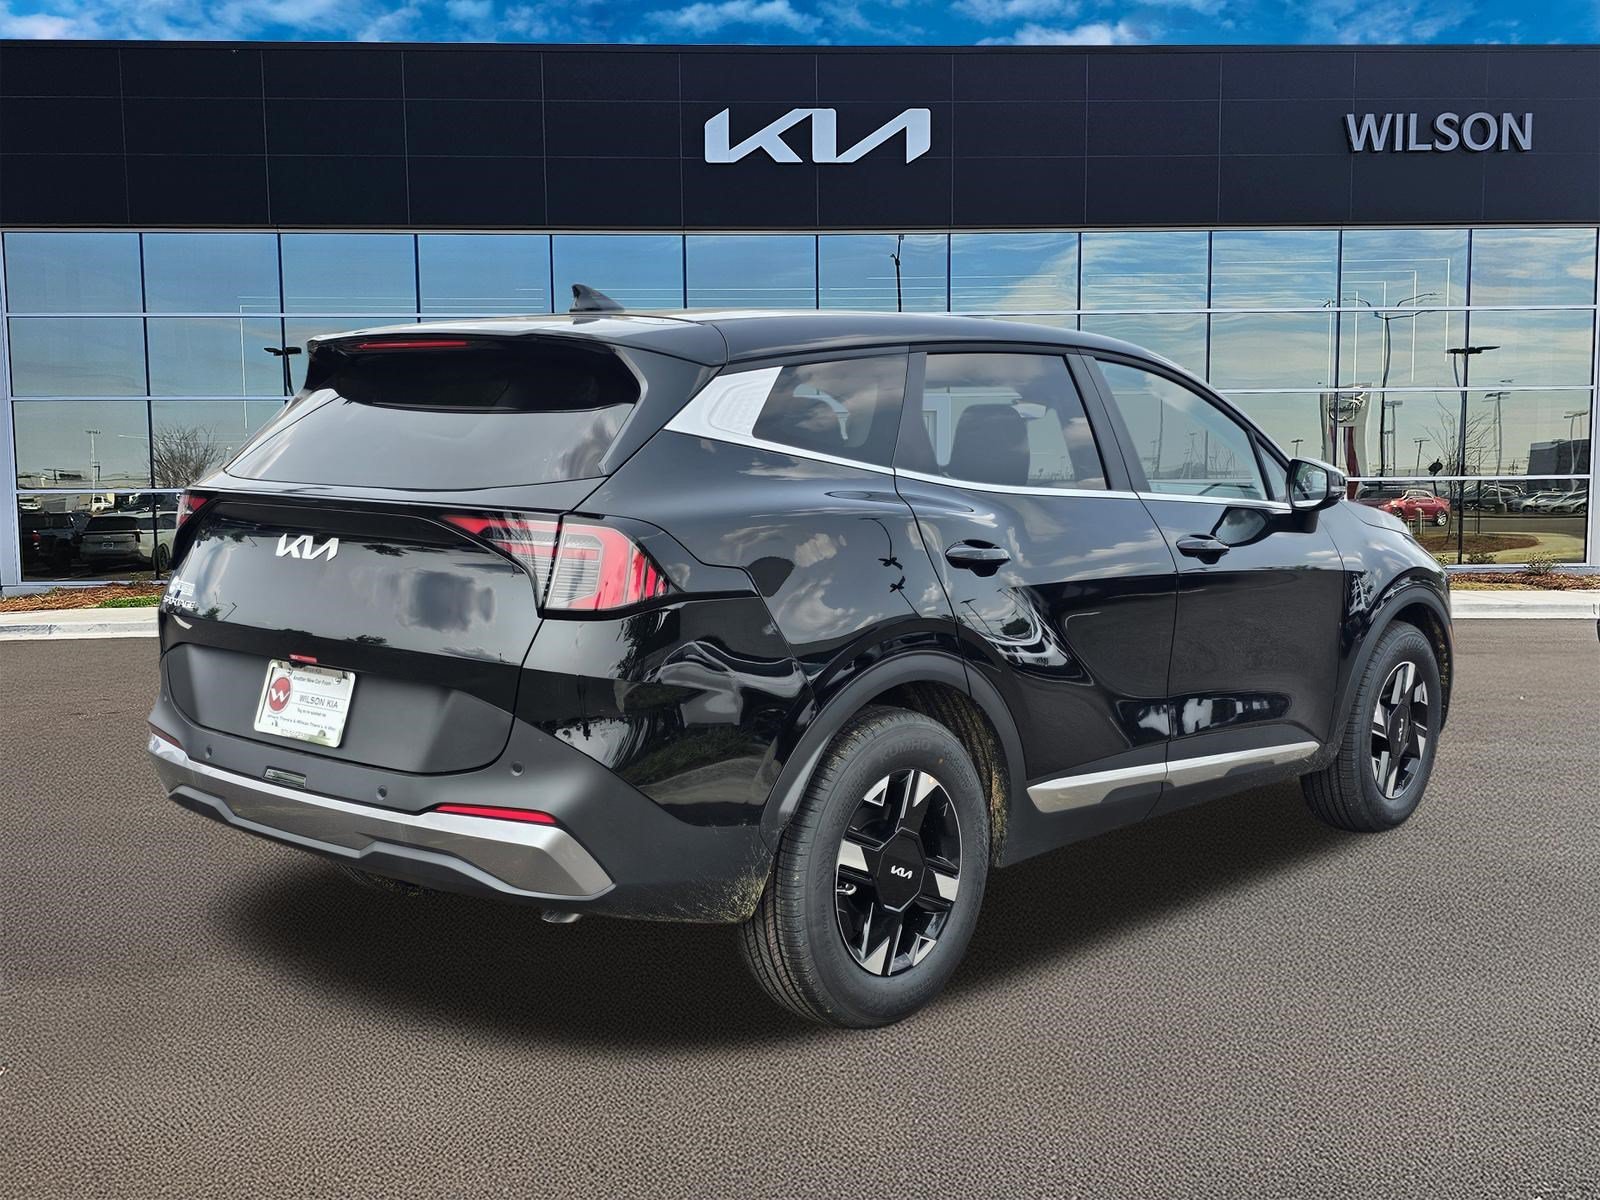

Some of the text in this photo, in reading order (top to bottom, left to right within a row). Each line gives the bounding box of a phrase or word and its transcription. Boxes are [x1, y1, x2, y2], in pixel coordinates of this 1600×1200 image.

[705, 108, 931, 164] KIA
[1345, 112, 1534, 152] WILSON
[275, 533, 339, 561] KIA
[299, 695, 338, 709] WILSON KIA
[890, 865, 913, 880] KIA
